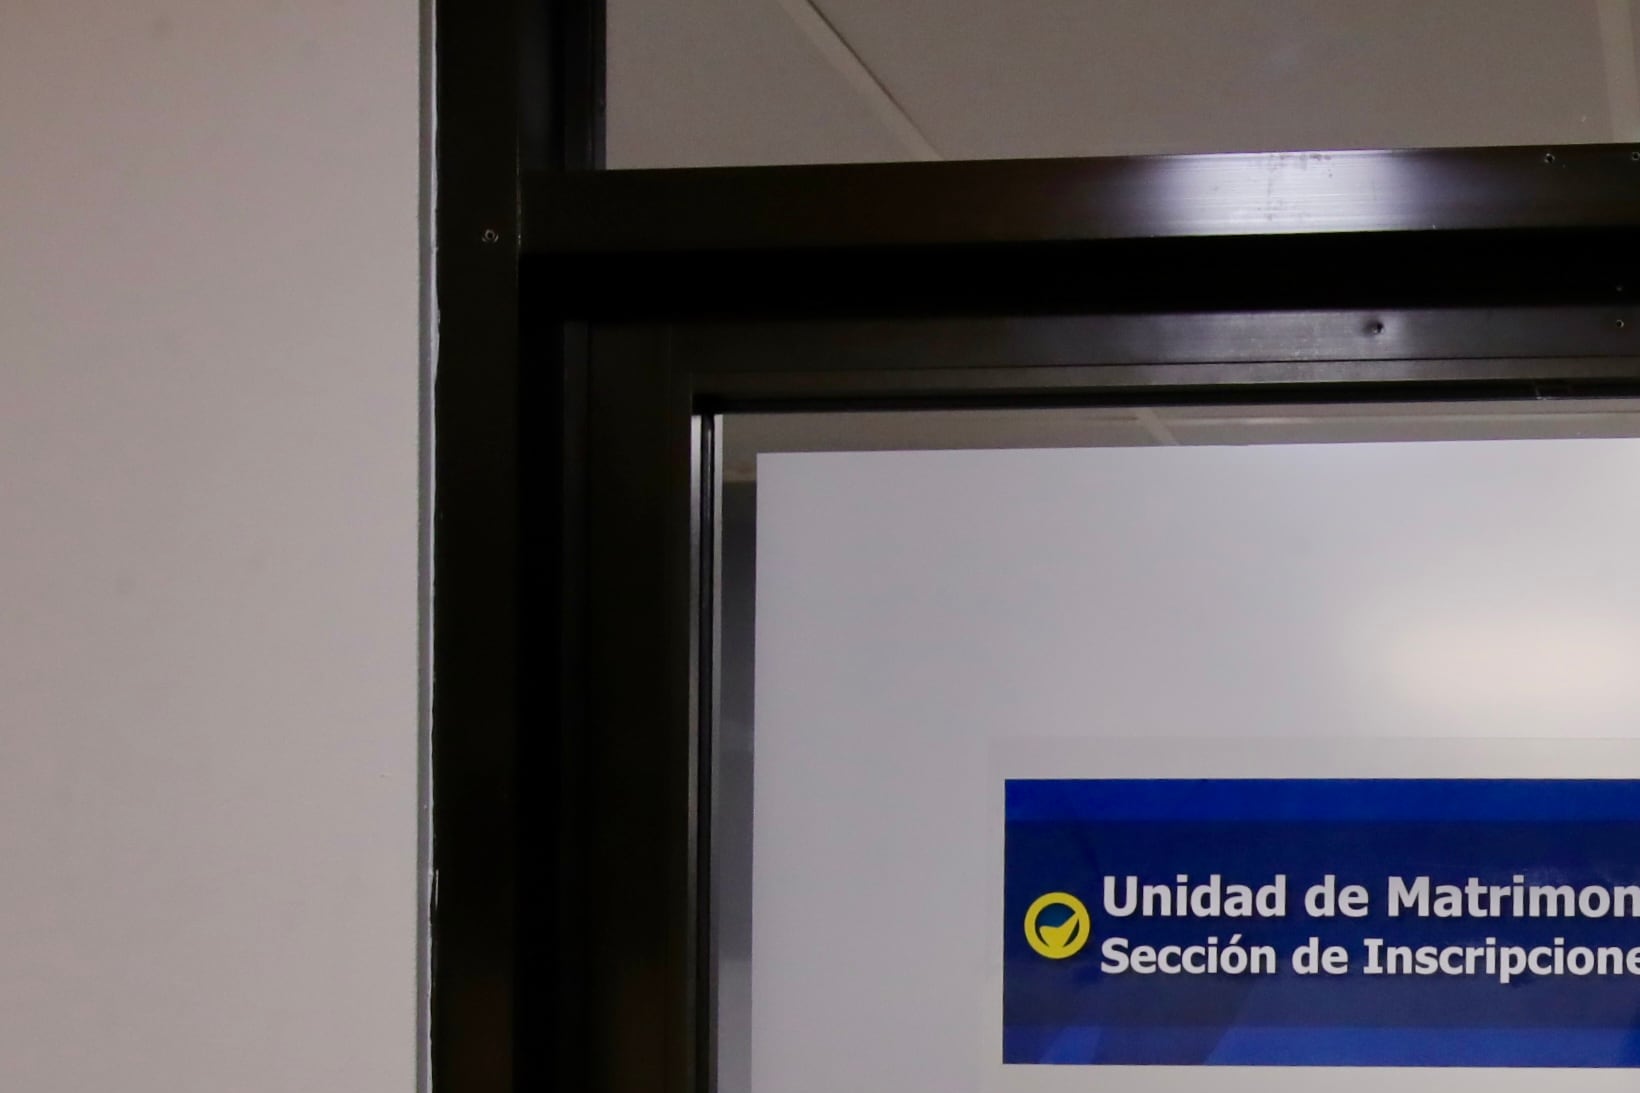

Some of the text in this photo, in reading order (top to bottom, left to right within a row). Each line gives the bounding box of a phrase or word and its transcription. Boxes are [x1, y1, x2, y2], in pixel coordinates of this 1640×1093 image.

[1104, 875, 1285, 917] Unidad
[1305, 875, 1368, 917] de
[1101, 934, 1275, 974] Sección
[1292, 937, 1348, 974] de
